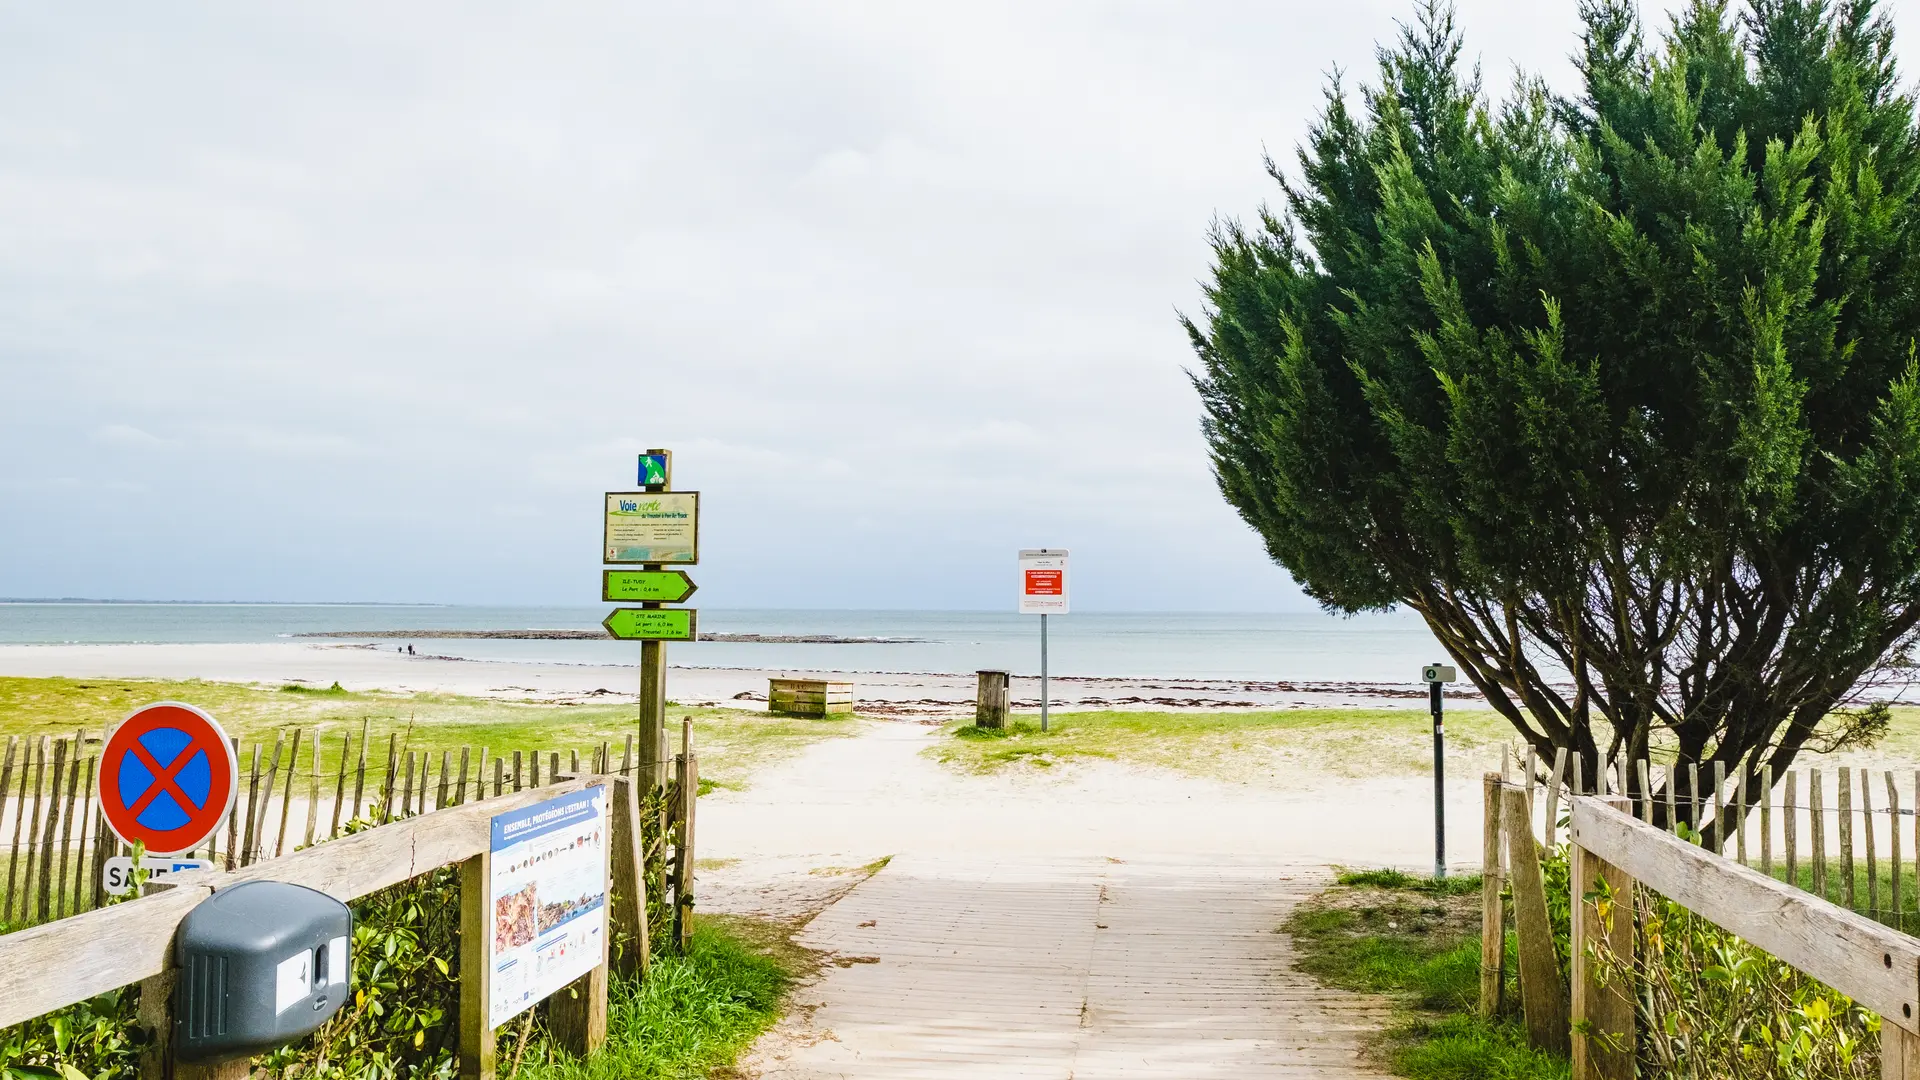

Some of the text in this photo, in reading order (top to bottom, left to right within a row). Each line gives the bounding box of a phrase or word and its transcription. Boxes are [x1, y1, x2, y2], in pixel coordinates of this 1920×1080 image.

[620, 499, 661, 512] Voie verte
[109, 867, 168, 888] SAF
